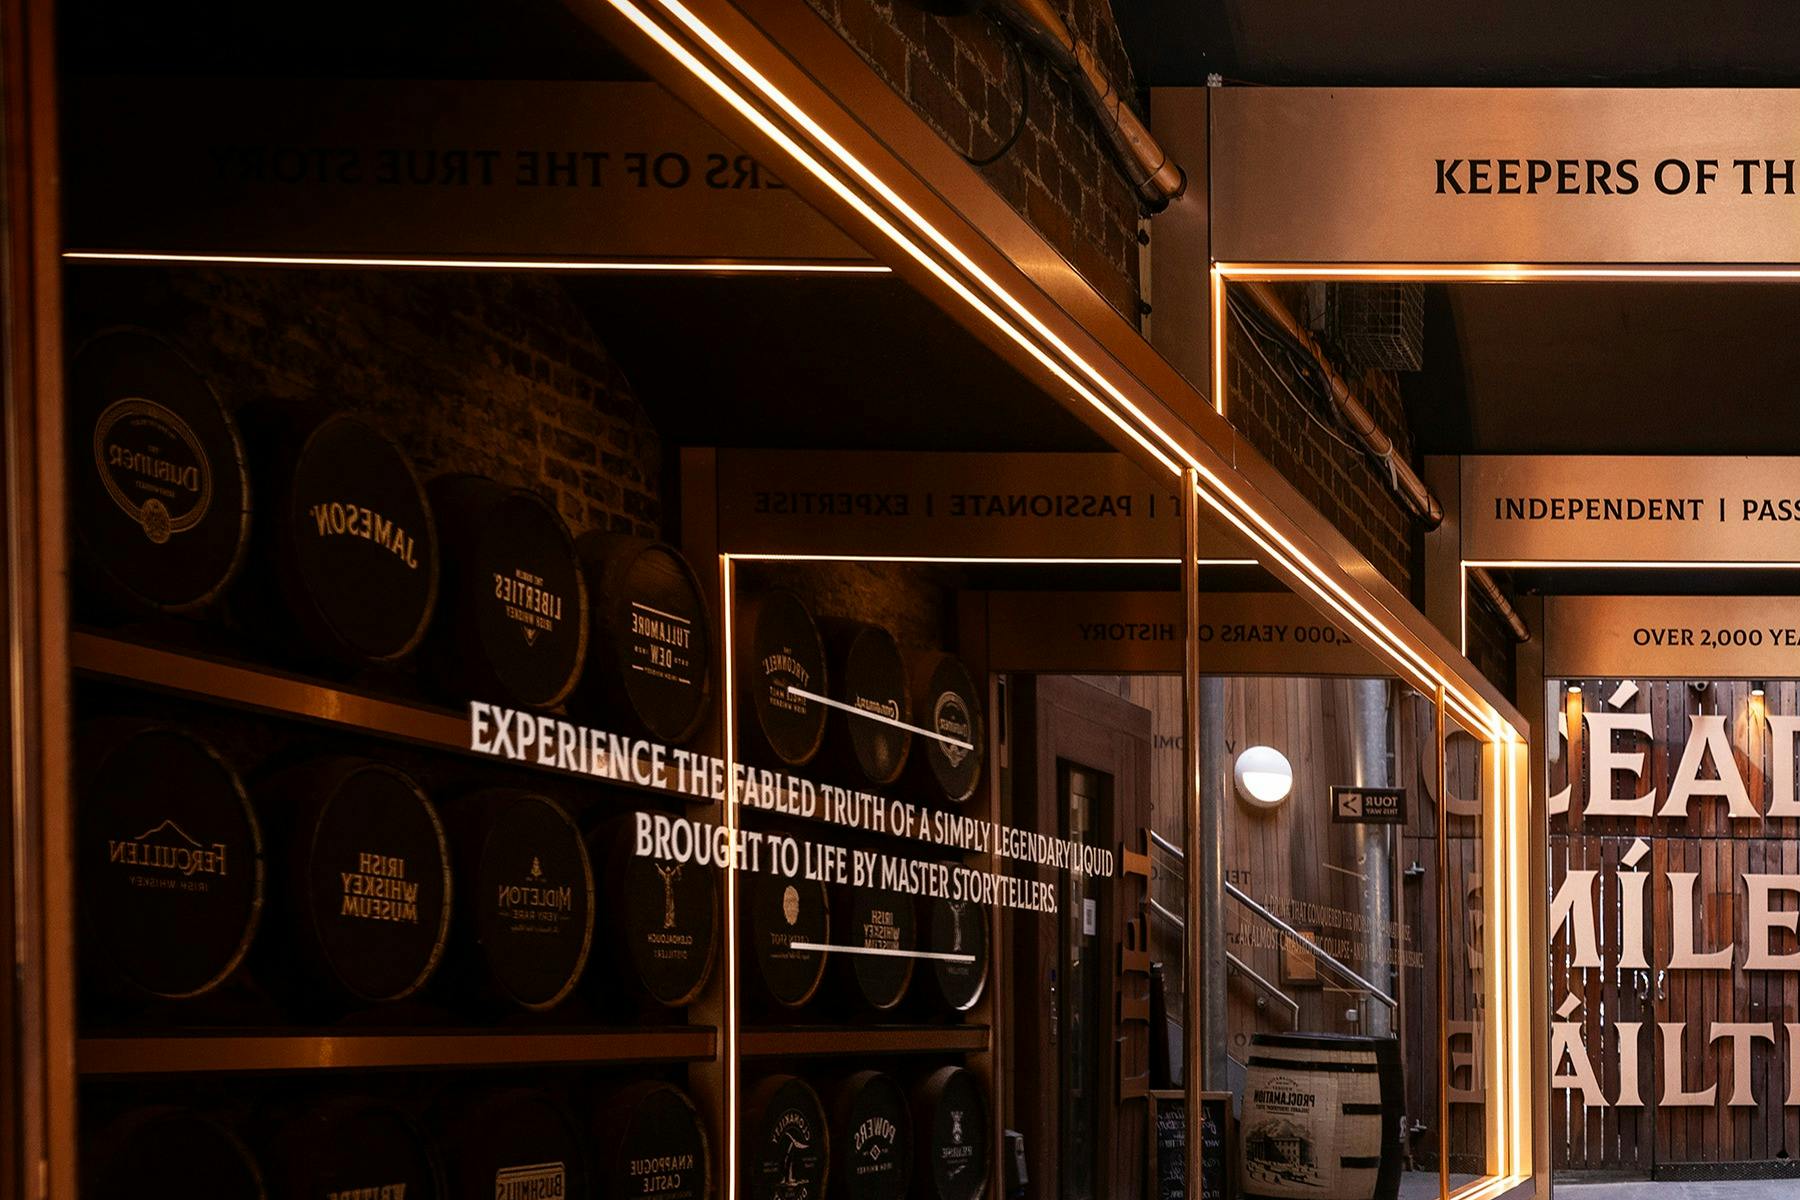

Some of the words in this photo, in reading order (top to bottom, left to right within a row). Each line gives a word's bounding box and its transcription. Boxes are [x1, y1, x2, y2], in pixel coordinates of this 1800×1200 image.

[1434, 158, 1639, 196] KEEPERS
[1653, 158, 1719, 196] OF
[1494, 496, 1704, 523] INDEPENDENT
[1632, 628, 1697, 648] OVER
[1700, 628, 1763, 652] 2,000
[471, 700, 669, 790] EXPERIENCE
[674, 748, 726, 801] THE
[733, 762, 817, 819] FABLED
[821, 784, 887, 834] TRUTH
[890, 799, 915, 838] OF
[919, 806, 931, 843] A
[935, 809, 991, 854] SIMPLY
[993, 823, 1073, 869] LEGENDARY
[1073, 841, 1114, 879] LIQUID
[636, 811, 764, 873] BROUGHT
[768, 836, 800, 879] TO
[805, 841, 848, 885] LIFE
[854, 850, 879, 889] BY
[882, 854, 950, 899] MASTER
[953, 868, 1059, 914] STORYTELLERS.
